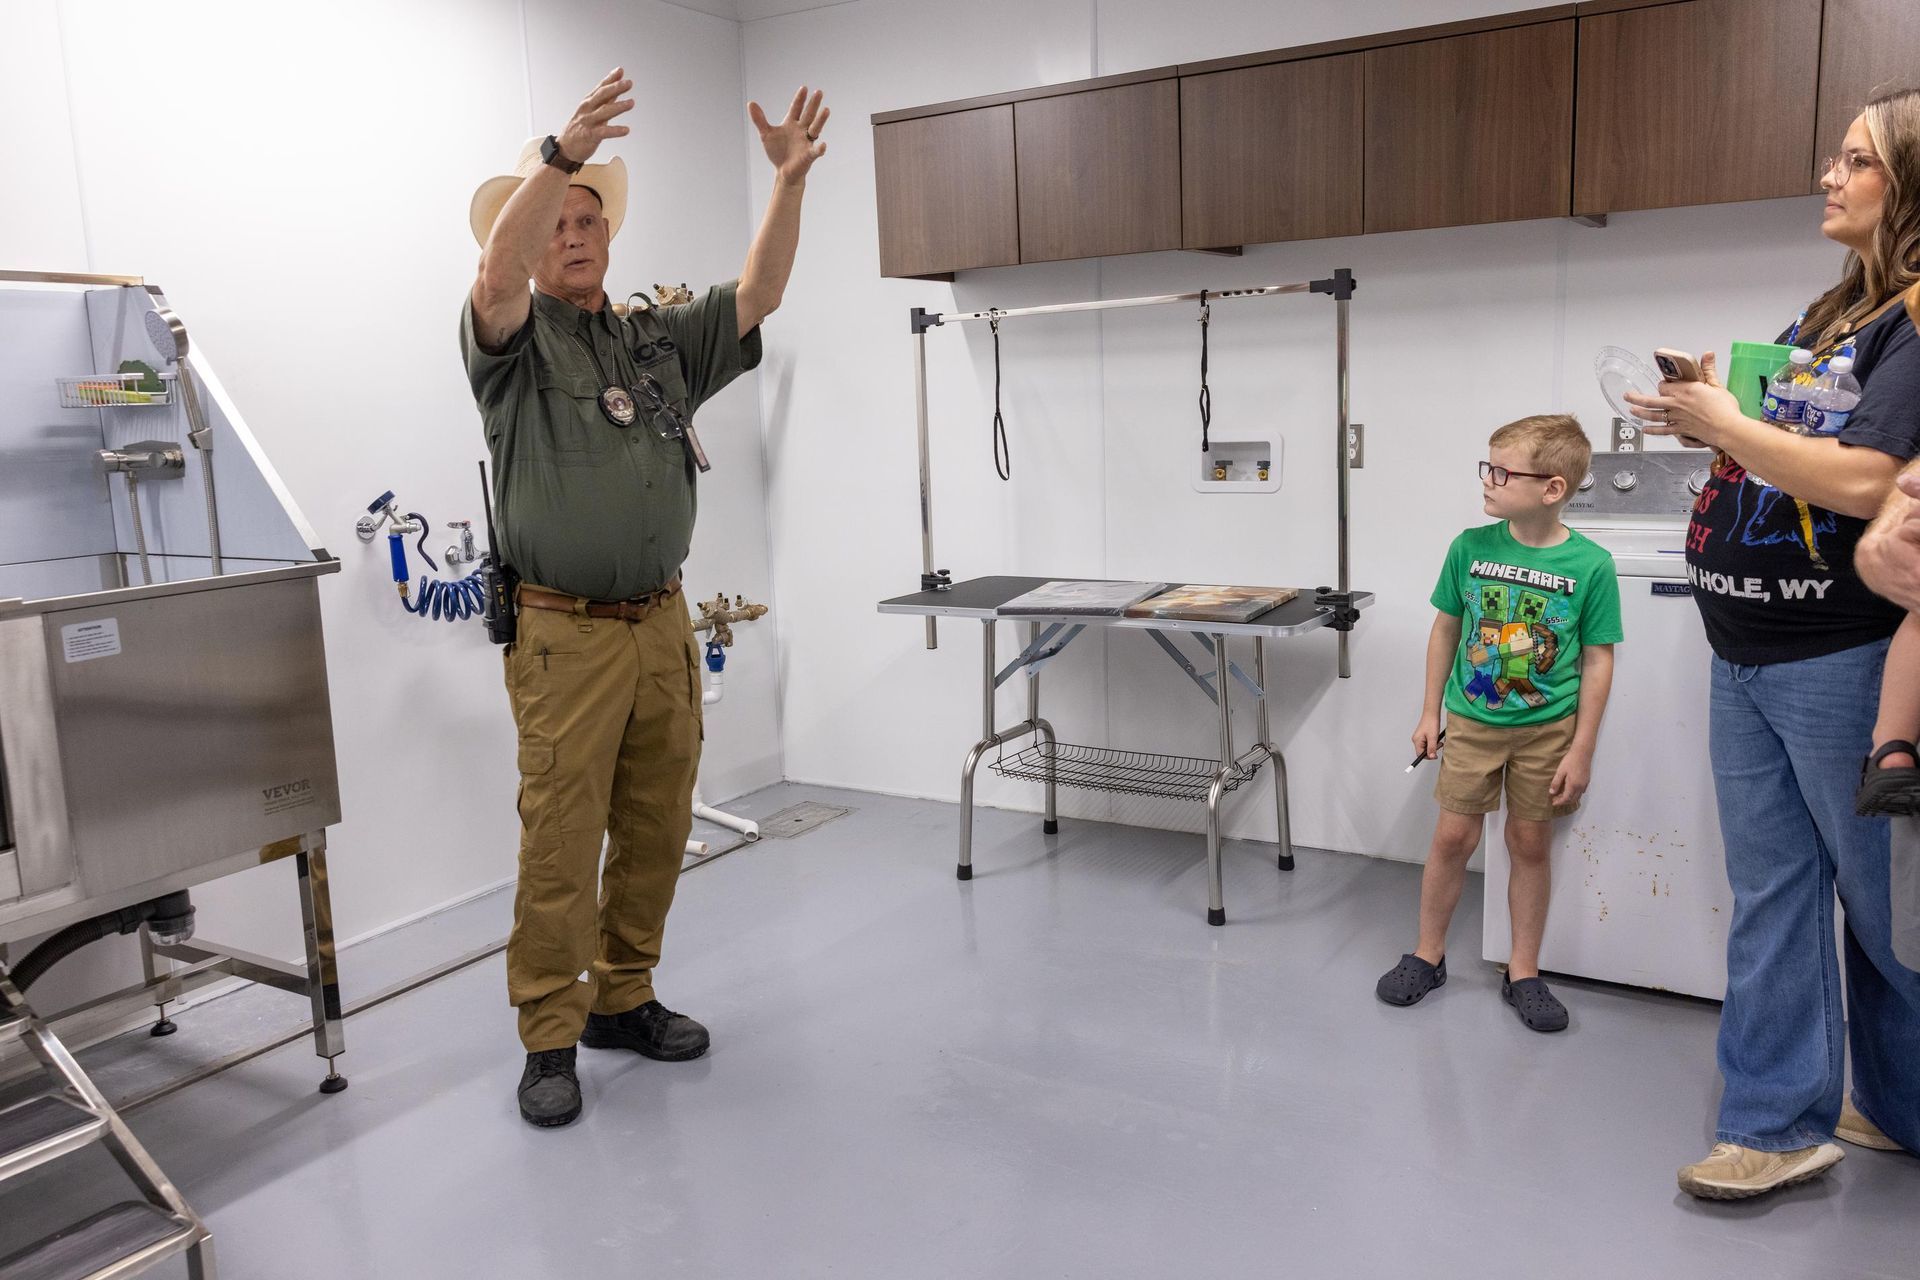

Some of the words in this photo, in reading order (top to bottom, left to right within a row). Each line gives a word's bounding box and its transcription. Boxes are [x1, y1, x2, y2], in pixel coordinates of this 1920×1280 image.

[1469, 560, 1577, 595] MINECRAFT
[1653, 584, 1691, 593] MAYTAG
[1699, 568, 1770, 602] HOLE,
[1778, 578, 1834, 600] WY
[262, 779, 311, 800] VEVOR
